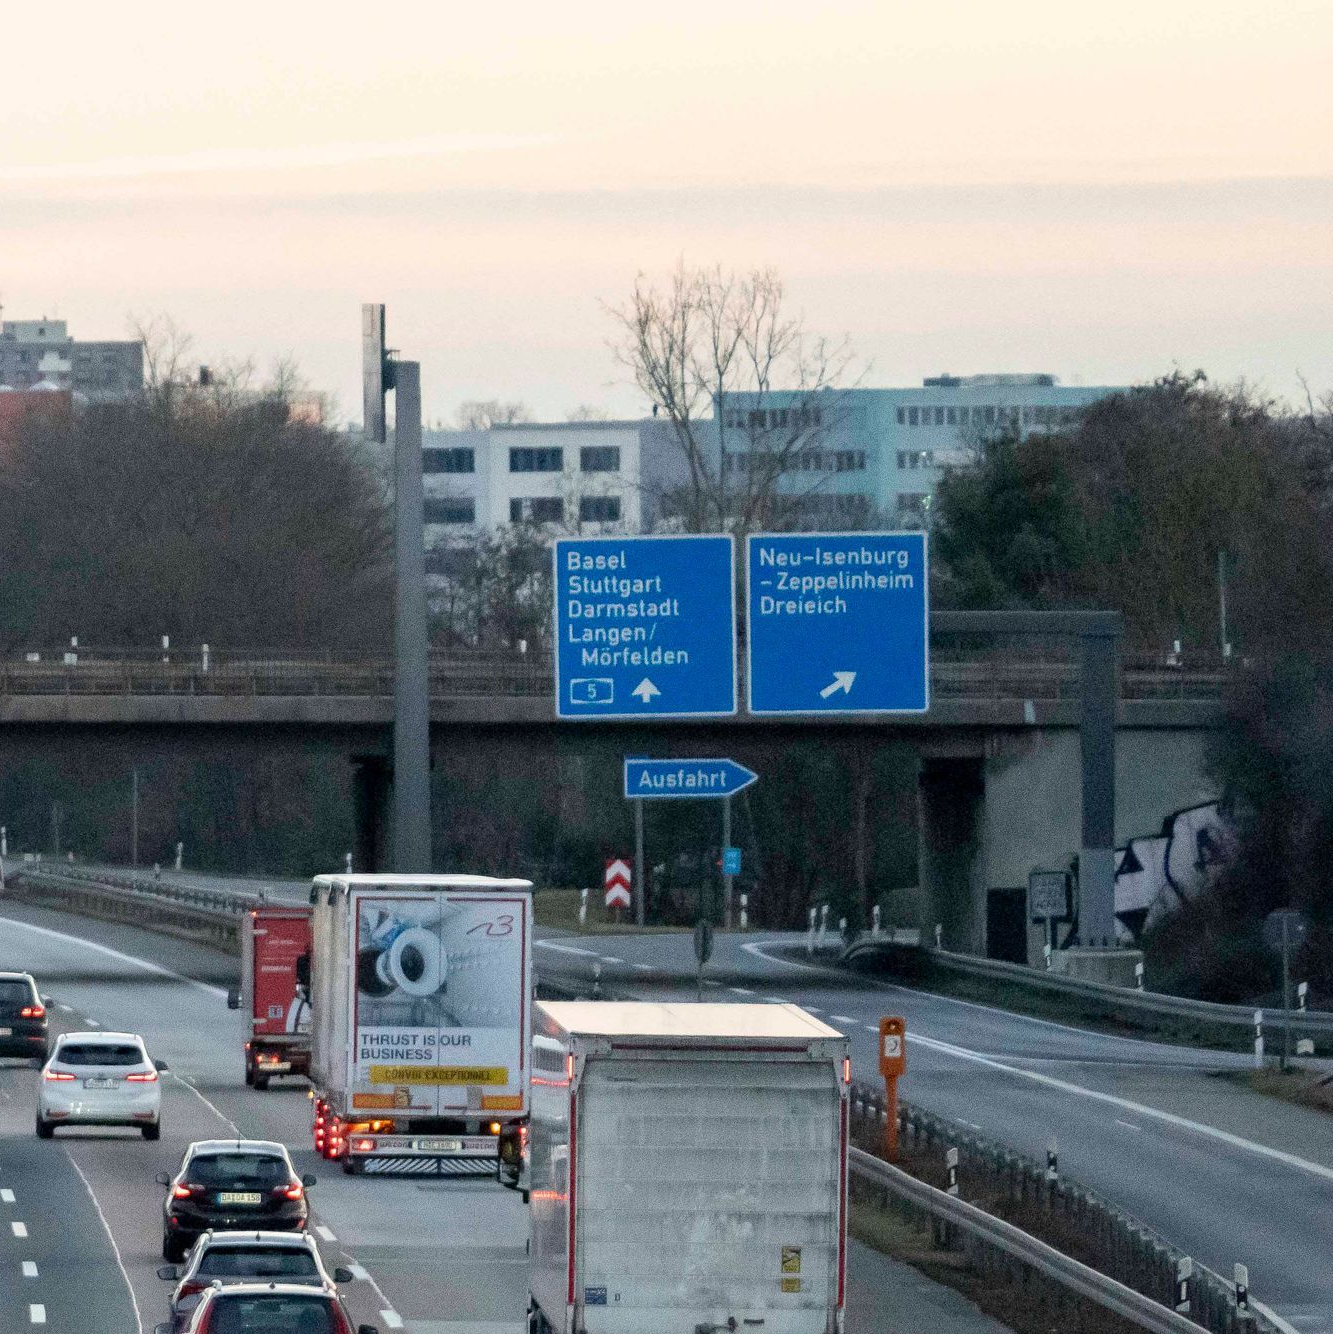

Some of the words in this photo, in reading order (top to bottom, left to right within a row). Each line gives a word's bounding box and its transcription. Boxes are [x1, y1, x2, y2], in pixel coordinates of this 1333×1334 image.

[567, 550, 626, 570] Basel
[759, 547, 910, 569] Neu-Isenburg
[568, 576, 662, 596] Stuttgart
[776, 570, 914, 593] Zeppelinheim
[567, 600, 680, 618] Darmstadt
[760, 596, 847, 615] Dreieich
[568, 623, 656, 646] Langen/
[581, 647, 689, 666] Mörfelden
[587, 683, 597, 699] 5
[638, 769, 727, 788] Ausfahrt
[361, 1034, 419, 1046] THRUST
[423, 1034, 436, 1046] IS
[440, 1034, 471, 1046] OUR
[361, 1048, 433, 1060] BUSINESS
